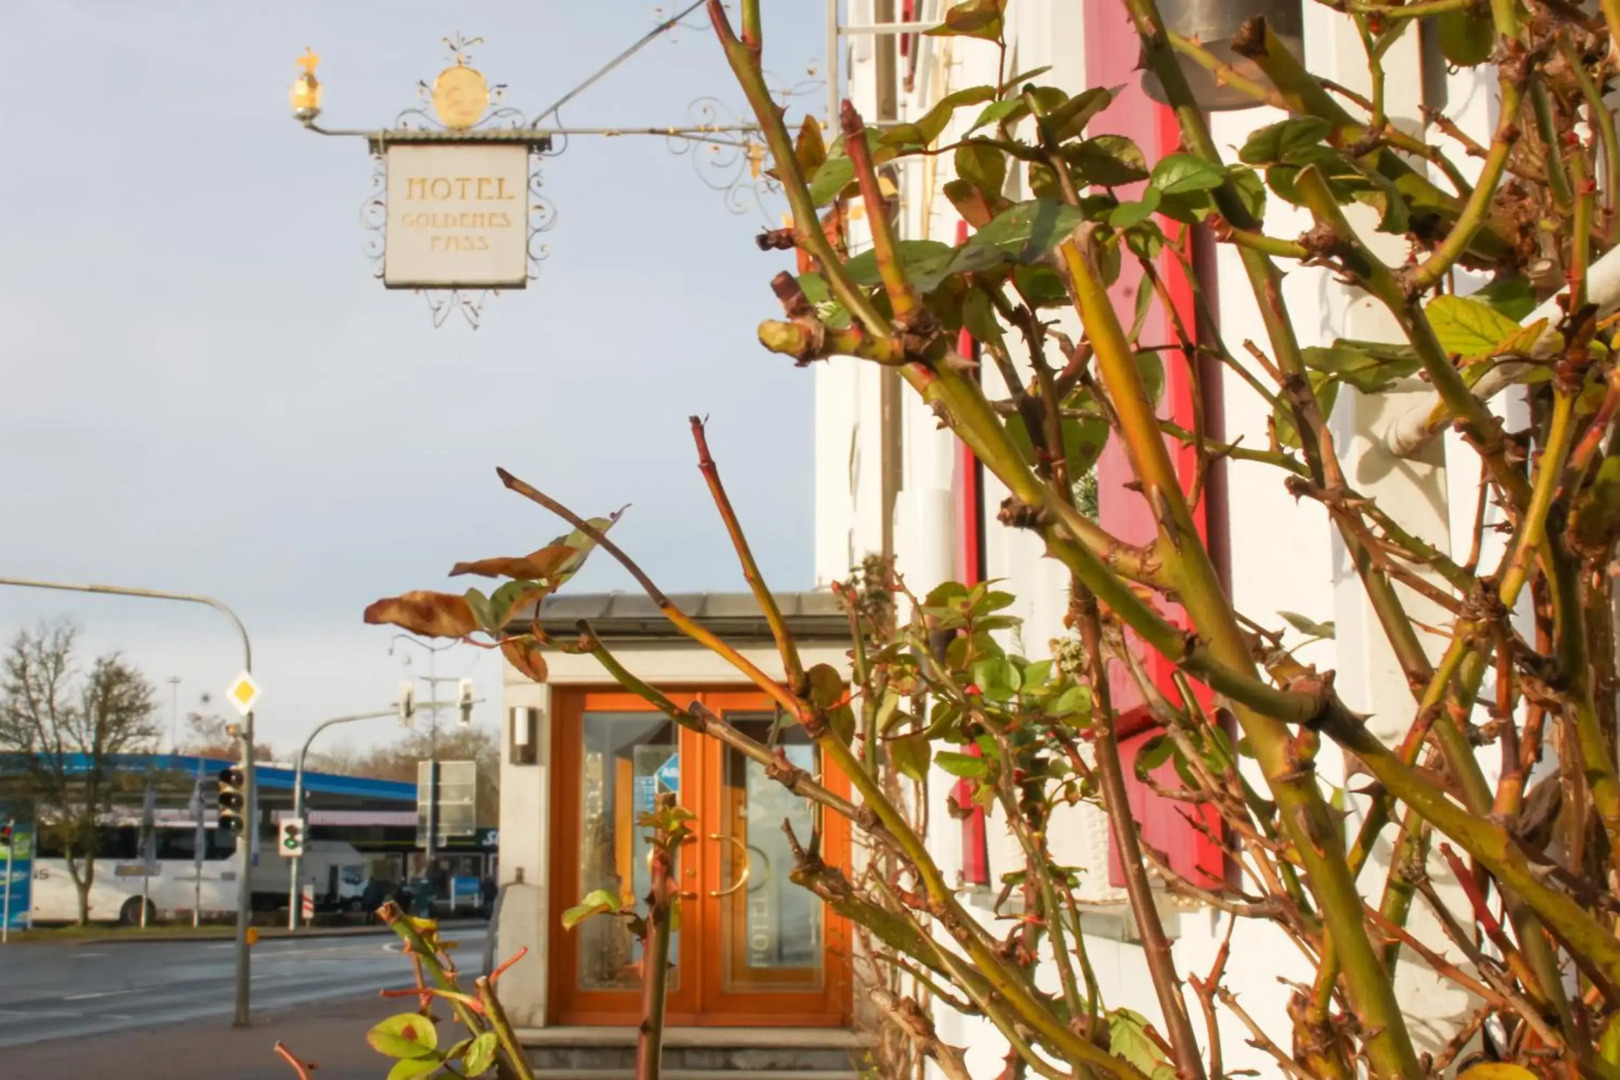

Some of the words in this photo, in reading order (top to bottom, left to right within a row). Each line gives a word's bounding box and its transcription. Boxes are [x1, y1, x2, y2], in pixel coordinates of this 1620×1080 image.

[406, 177, 516, 200] HOTEL
[402, 212, 512, 229] GOLDENES
[430, 236, 490, 251] FASS
